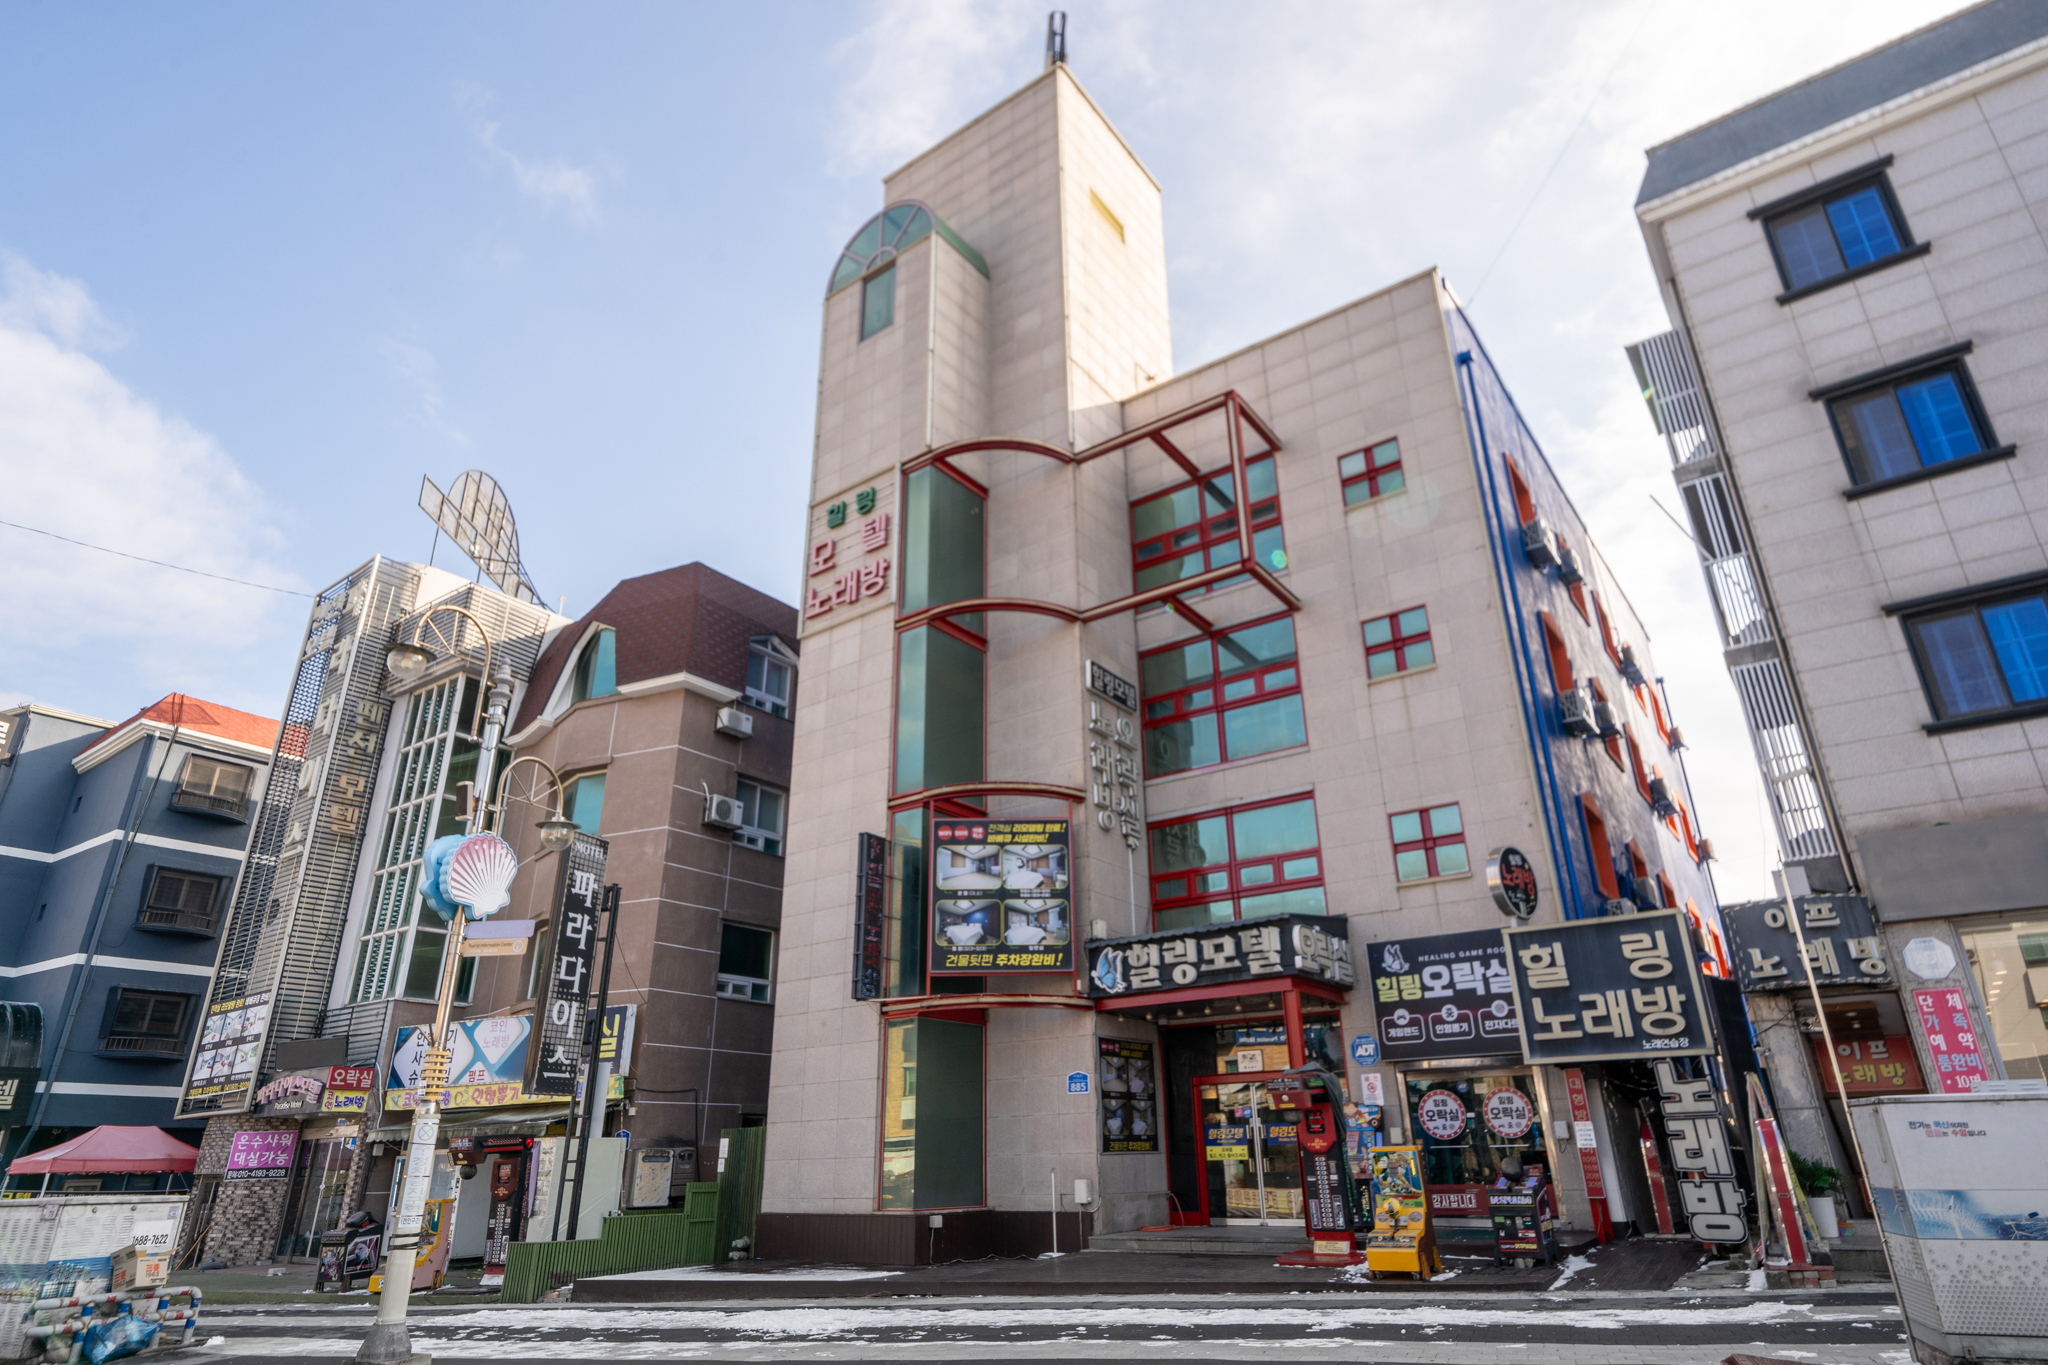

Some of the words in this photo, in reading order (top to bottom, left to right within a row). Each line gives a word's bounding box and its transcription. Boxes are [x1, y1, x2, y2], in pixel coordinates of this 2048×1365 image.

[827, 486, 876, 529] 힐링
[808, 513, 889, 578] 모텔
[805, 558, 890, 619] 노래방
[1092, 663, 1137, 709] 힐링모텔
[346, 699, 384, 756] 펜션
[1090, 700, 1120, 831] 노래방
[1114, 716, 1142, 839] 오락실
[330, 773, 366, 835] 모텔
[575, 841, 605, 860] MOTEL
[1501, 863, 1536, 896] 노래방
[1764, 902, 1841, 933] 이프
[946, 954, 993, 967] 건물뒷편
[995, 953, 1063, 967] 주차장완비!
[1125, 925, 1284, 990] 힐링모텔
[1292, 924, 1355, 984] 오락실
[1418, 953, 1456, 962] HEALING
[1458, 949, 1484, 958] GAME
[1518, 930, 1674, 989] 힐링
[1748, 936, 1887, 979] 노래방
[543, 869, 598, 1078] 파라다이스
[1376, 974, 1423, 1002] 힐링
[1531, 985, 1687, 1041] 노래방
[489, 1020, 508, 1033] 코인
[482, 1035, 510, 1049] 노래방
[1356, 1044, 1375, 1057] ADT
[1838, 1040, 1890, 1060] 이프
[1937, 1053, 1982, 1072] 룸완비
[331, 1069, 374, 1088] 오락실
[468, 1070, 485, 1083] 펌프
[1070, 1083, 1086, 1091] 885
[256, 1076, 323, 1105] 파라다이스모텔
[471, 1083, 520, 1105] 인형뽑기
[334, 1094, 365, 1109] 노래방
[1426, 1109, 1459, 1121] 오락실
[1490, 1106, 1526, 1119] 오락실
[237, 1133, 293, 1149] 온수샤워
[1208, 1127, 1244, 1139] 힐링모텔
[1269, 1126, 1297, 1138] 힐링모
[234, 1151, 288, 1166] 대실가능
[1654, 1061, 1748, 1243] 노래방
[132, 1234, 168, 1246] 1688-7622
